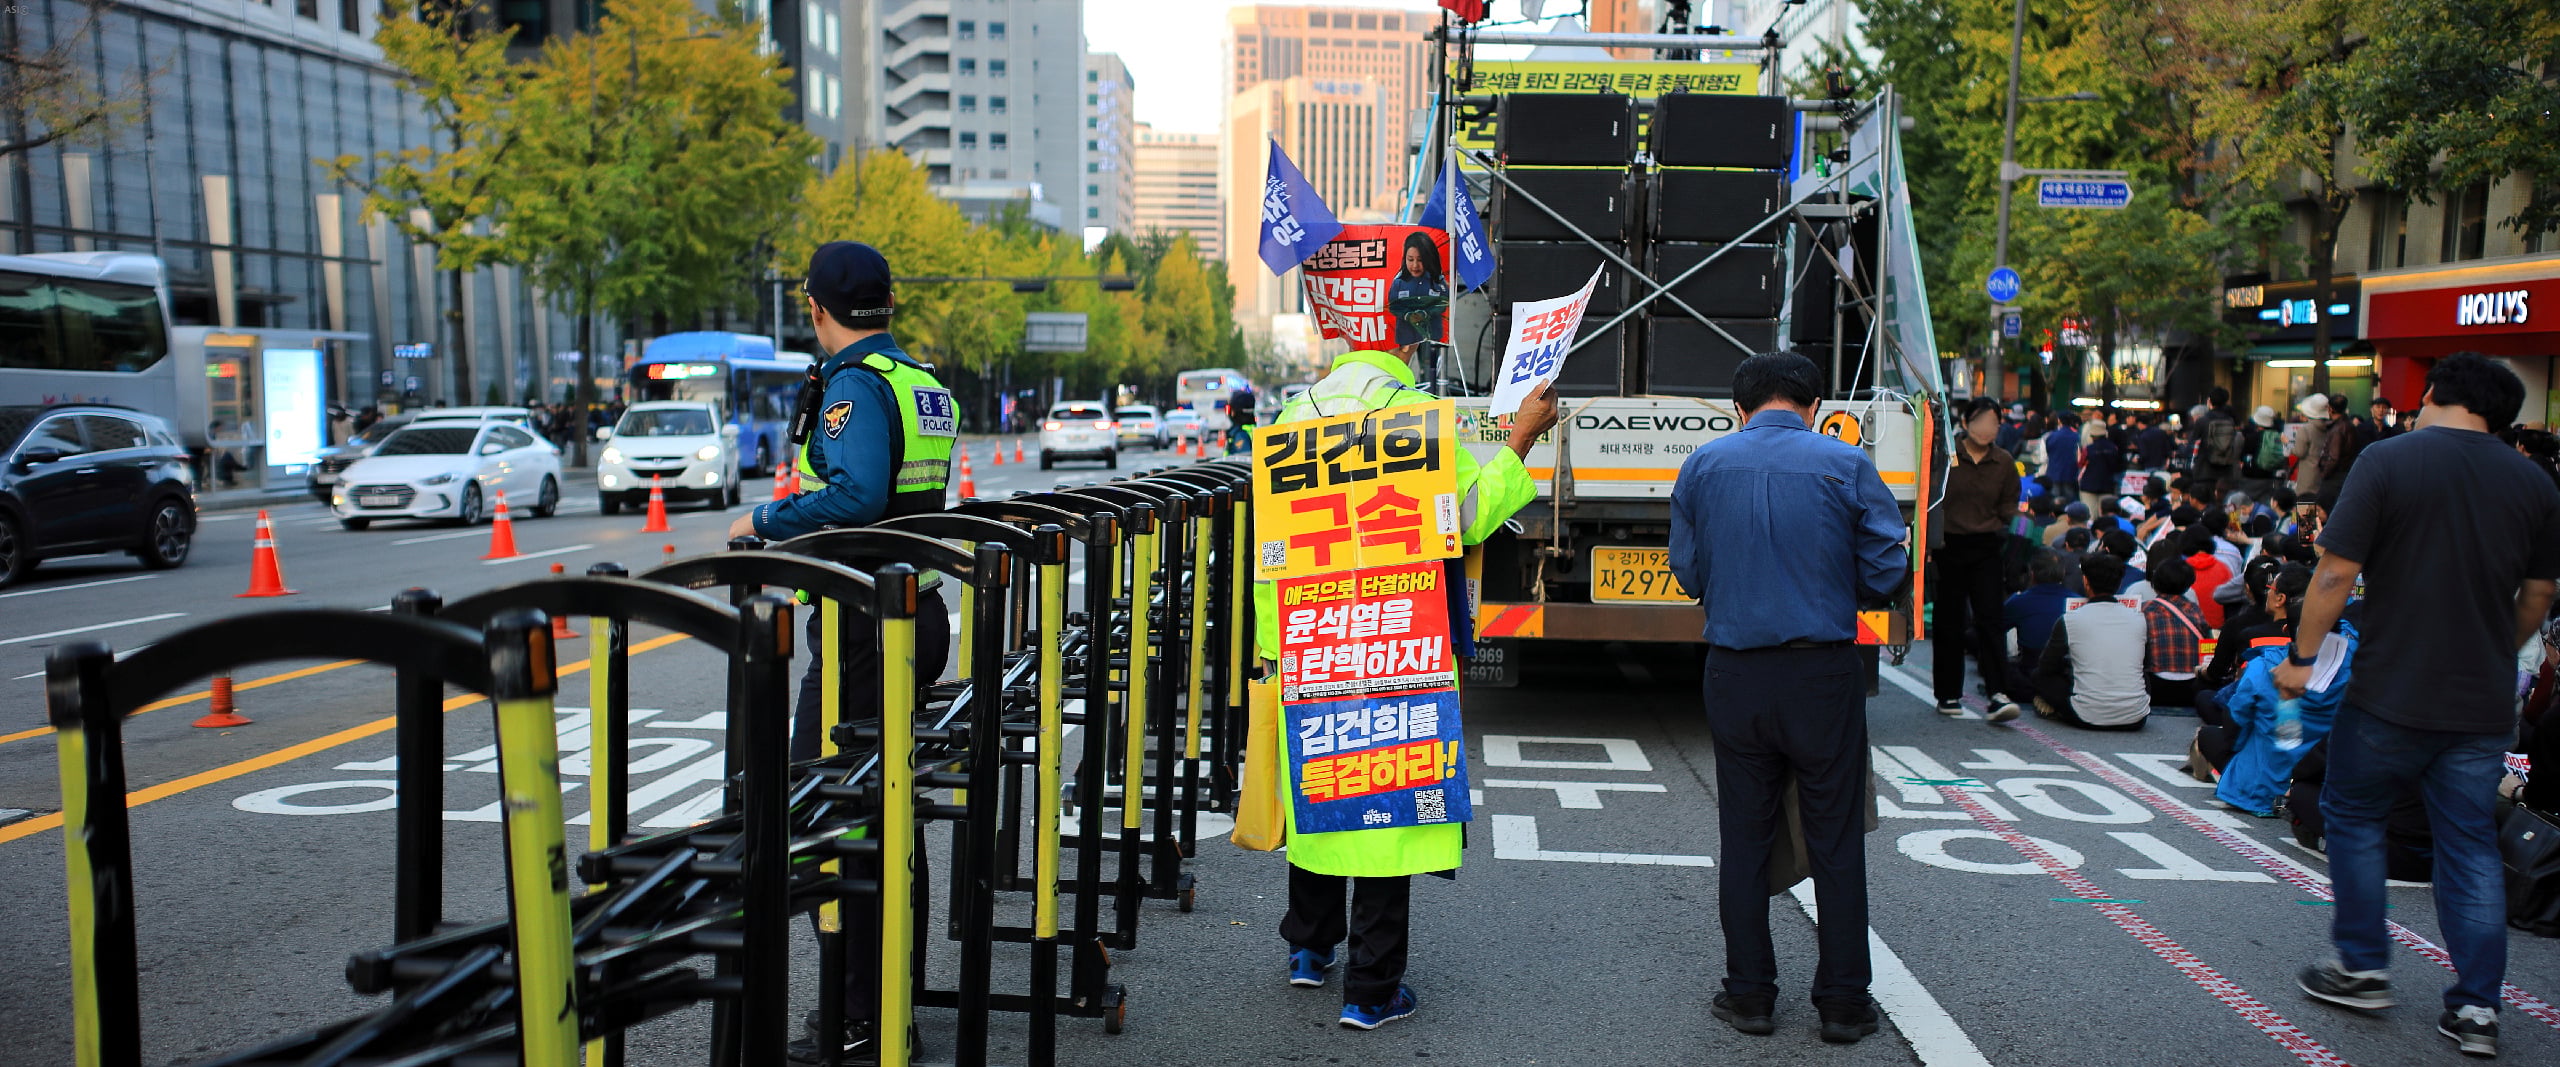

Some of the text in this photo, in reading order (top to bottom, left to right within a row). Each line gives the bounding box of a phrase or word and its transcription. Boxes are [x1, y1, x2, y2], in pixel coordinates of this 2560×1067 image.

[1525, 73, 1558, 90] 퇴진
[1564, 73, 1614, 91] 김건희
[1618, 74, 1651, 91] 특검
[1262, 188, 1305, 247] 주당
[1305, 274, 1385, 313] 김건희
[2459, 290, 2529, 326] HOLLYS
[857, 308, 891, 317] POLICE
[917, 392, 951, 417] 경찰
[922, 419, 952, 432] POLICE
[1576, 415, 1734, 431] DAEWOO
[1264, 409, 1440, 495] 김건희
[1600, 443, 1654, 455] 최대적재량
[1290, 484, 1423, 567] 구속
[1620, 552, 1644, 566] 경기
[1284, 579, 1355, 606] 애국으로
[1361, 570, 1437, 598] 단결하여
[1600, 569, 1616, 589] 자
[1285, 598, 1413, 645] 윤석열을
[1301, 635, 1443, 683] 탄핵하자!
[1299, 701, 1439, 756] 김건희를
[1299, 740, 1459, 798] 특검하라!
